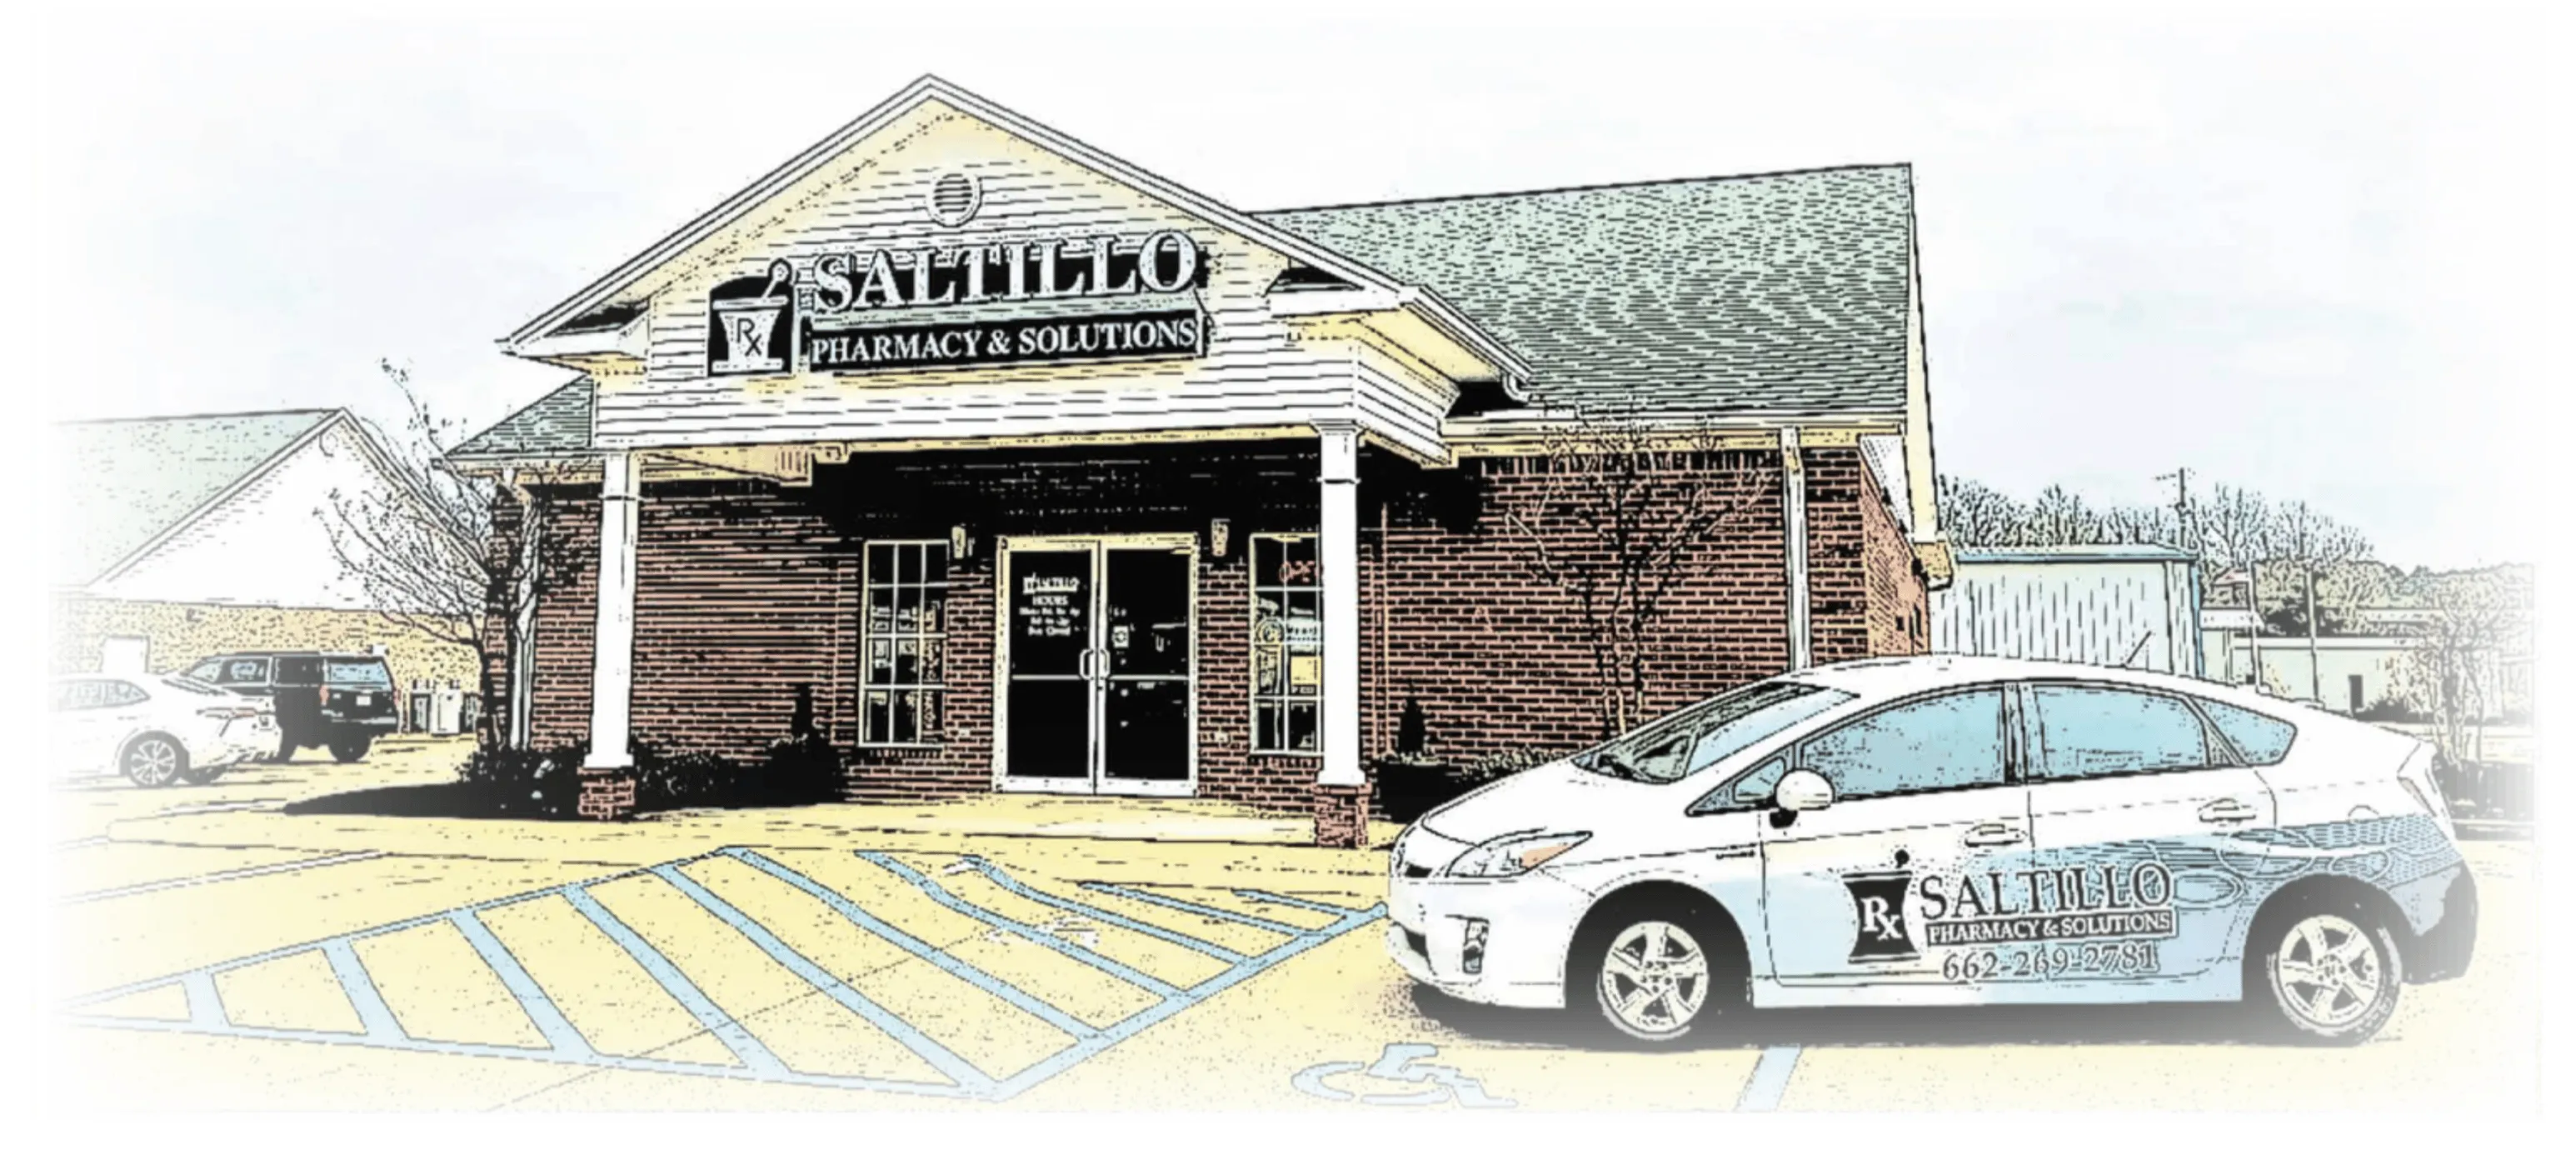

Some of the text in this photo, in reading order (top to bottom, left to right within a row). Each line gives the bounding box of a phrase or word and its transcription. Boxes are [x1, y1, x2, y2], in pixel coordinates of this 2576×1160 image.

[814, 231, 1197, 312] SALTILLO
[811, 318, 1196, 364] PHARMACY & SOLUTIONS
[1919, 862, 2171, 920] SALTILLO
[1929, 912, 2171, 944] PHARMACY & SOLUTIONS
[1943, 942, 2155, 981] 662-269-2781
